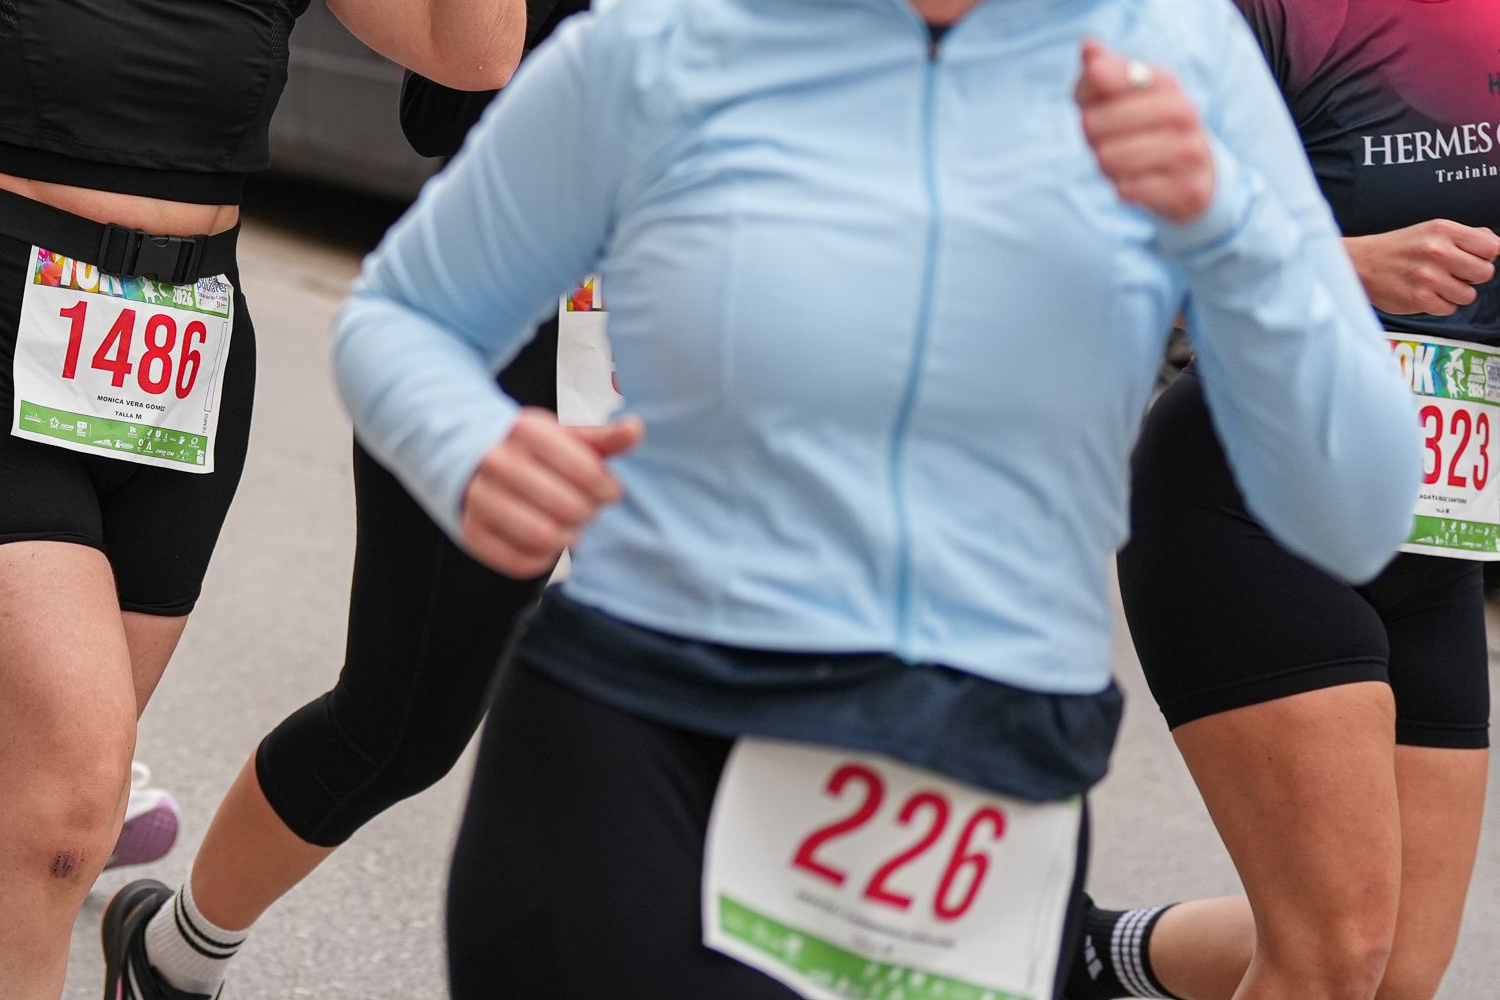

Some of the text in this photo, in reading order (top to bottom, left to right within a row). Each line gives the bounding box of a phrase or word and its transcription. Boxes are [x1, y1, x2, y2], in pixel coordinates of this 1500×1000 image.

[1361, 121, 1494, 166] HERMES
[172, 288, 193, 306] 2026
[59, 300, 207, 400] 1486
[97, 395, 124, 405] MONICA
[126, 400, 144, 408] VERA
[790, 761, 1008, 923] 226
